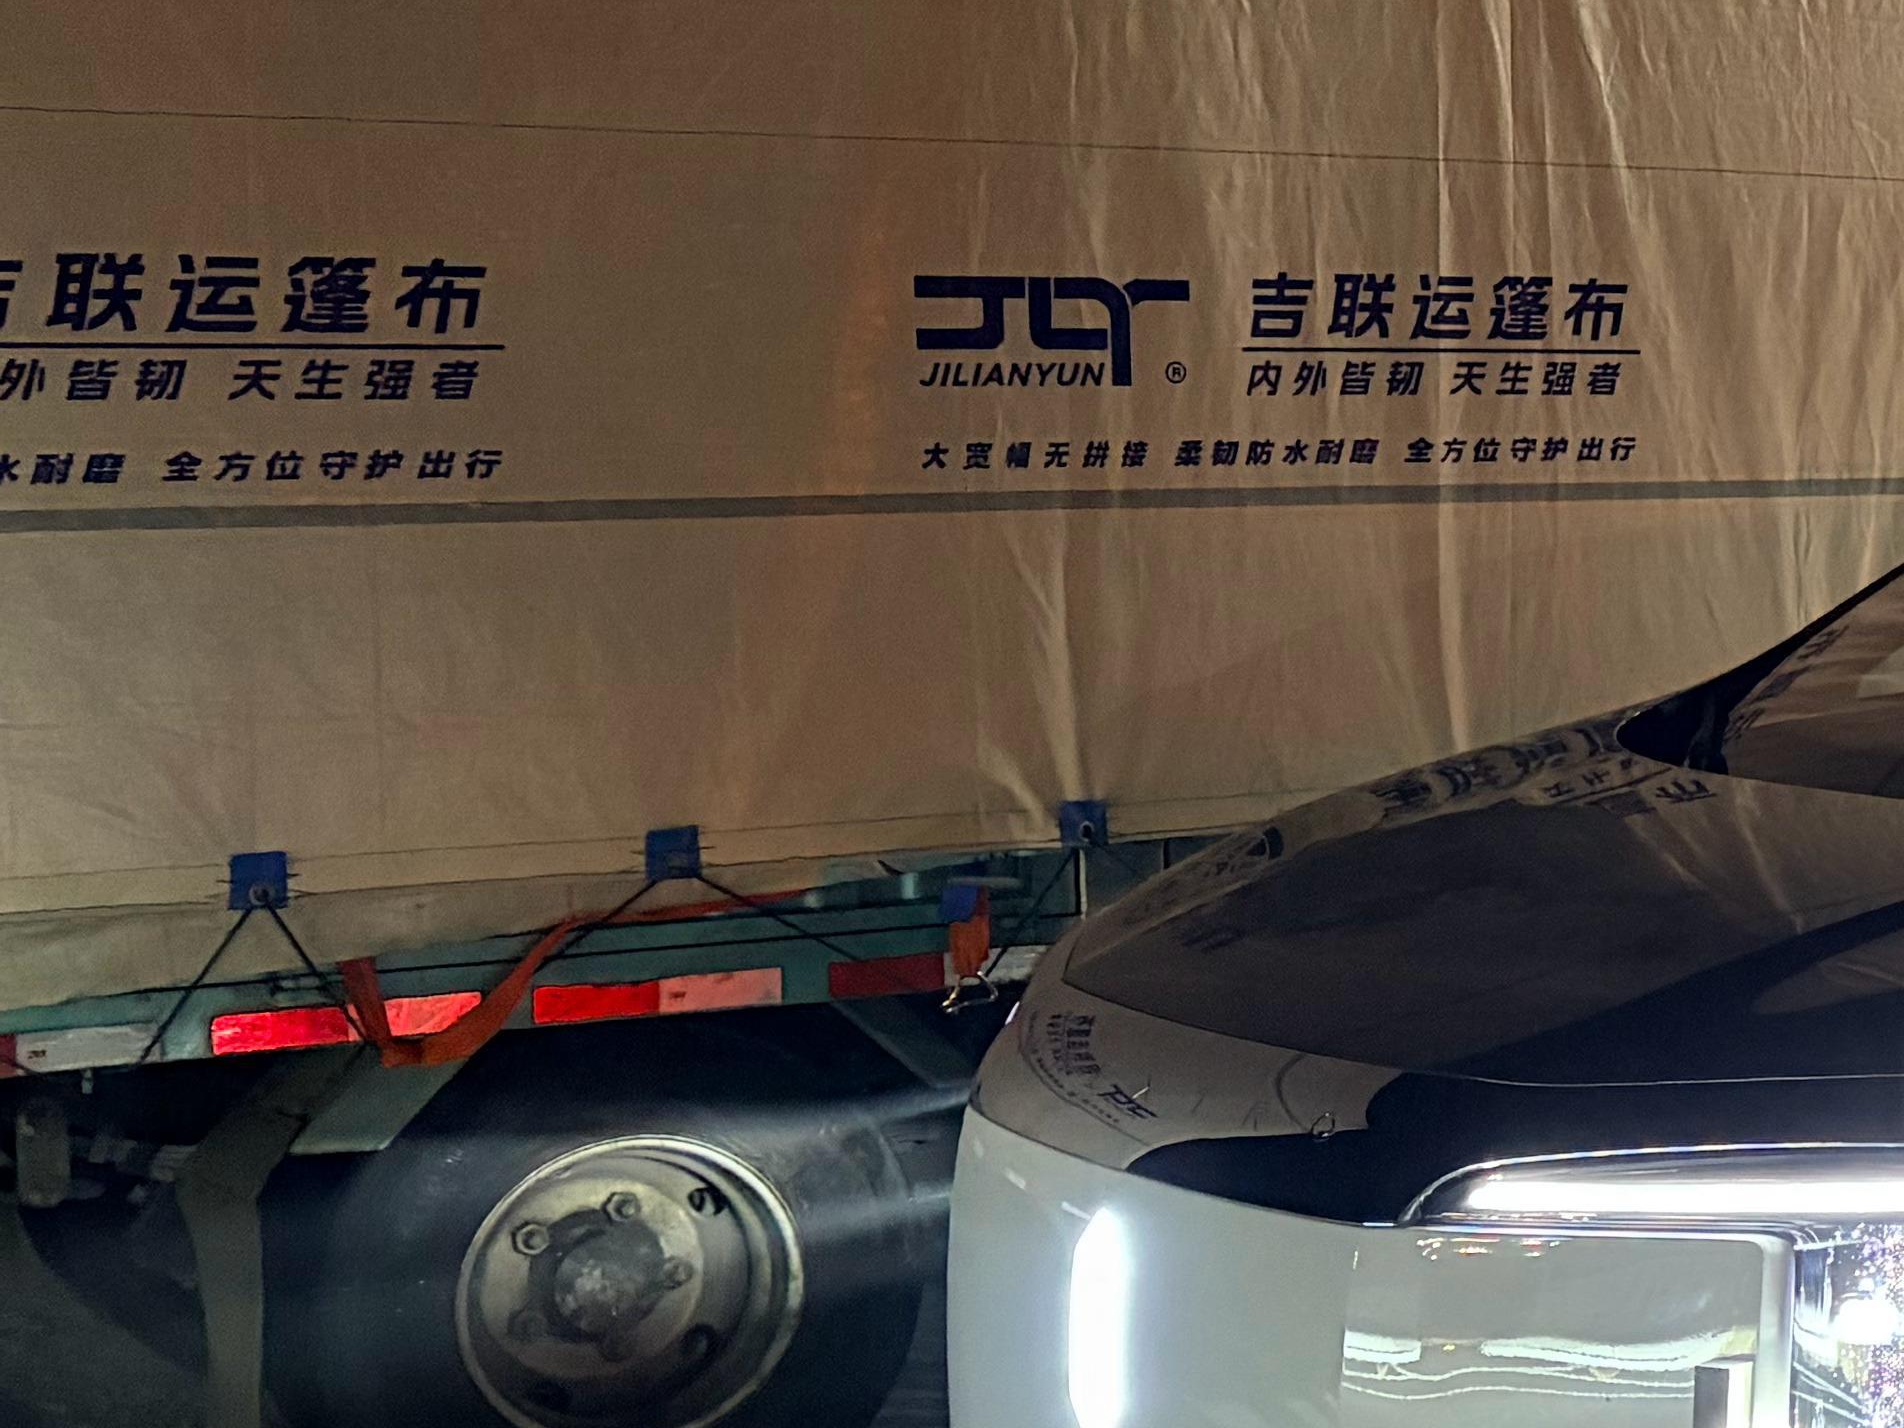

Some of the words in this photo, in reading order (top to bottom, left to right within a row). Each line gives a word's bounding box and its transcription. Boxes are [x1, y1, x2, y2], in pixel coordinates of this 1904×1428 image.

[1251, 273, 1629, 342] 吉联运篷布
[229, 359, 482, 401] 天生强者
[919, 361, 1105, 388] JILIANYUN
[1246, 360, 1424, 397] 内外皆韧
[1449, 360, 1623, 397] 天生强者
[162, 449, 505, 483] 全方位守护出行
[1174, 438, 1380, 467] 柔韧防水耐磨
[1404, 435, 1638, 465] 全方位守护出行
